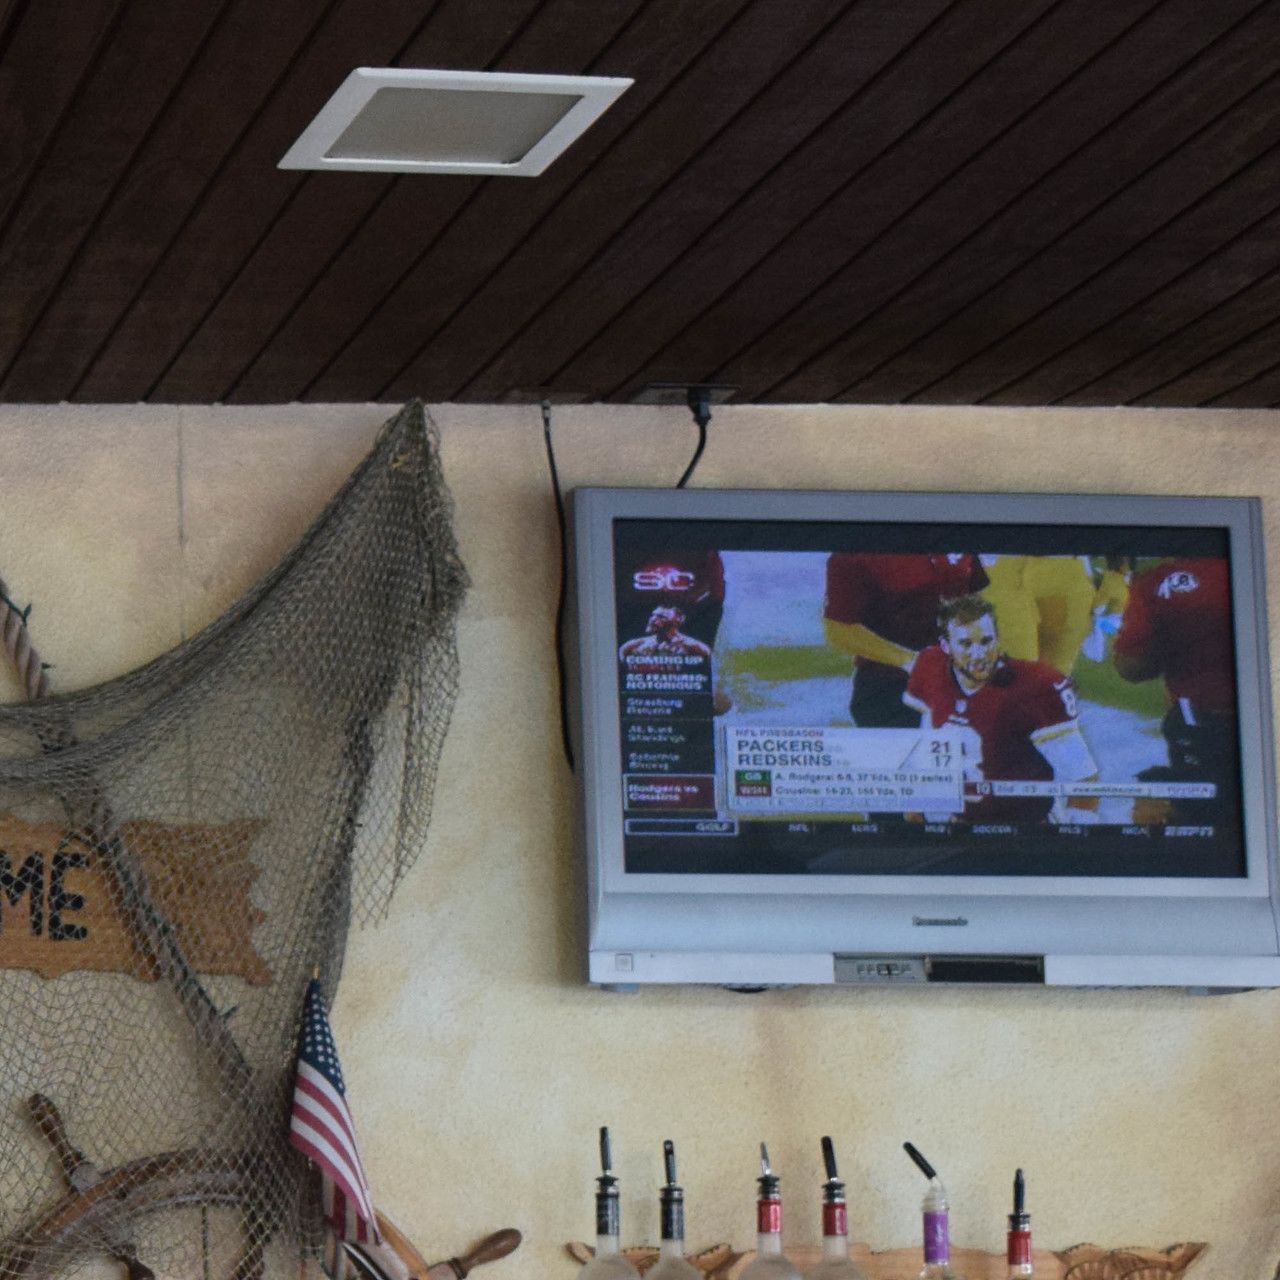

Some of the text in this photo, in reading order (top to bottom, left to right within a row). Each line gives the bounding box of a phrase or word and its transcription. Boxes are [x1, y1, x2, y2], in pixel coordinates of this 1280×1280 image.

[634, 572, 695, 591] SC
[625, 656, 683, 665] COMING
[737, 740, 950, 753] PACKERS 21
[737, 753, 952, 767] REDSKINS 17
